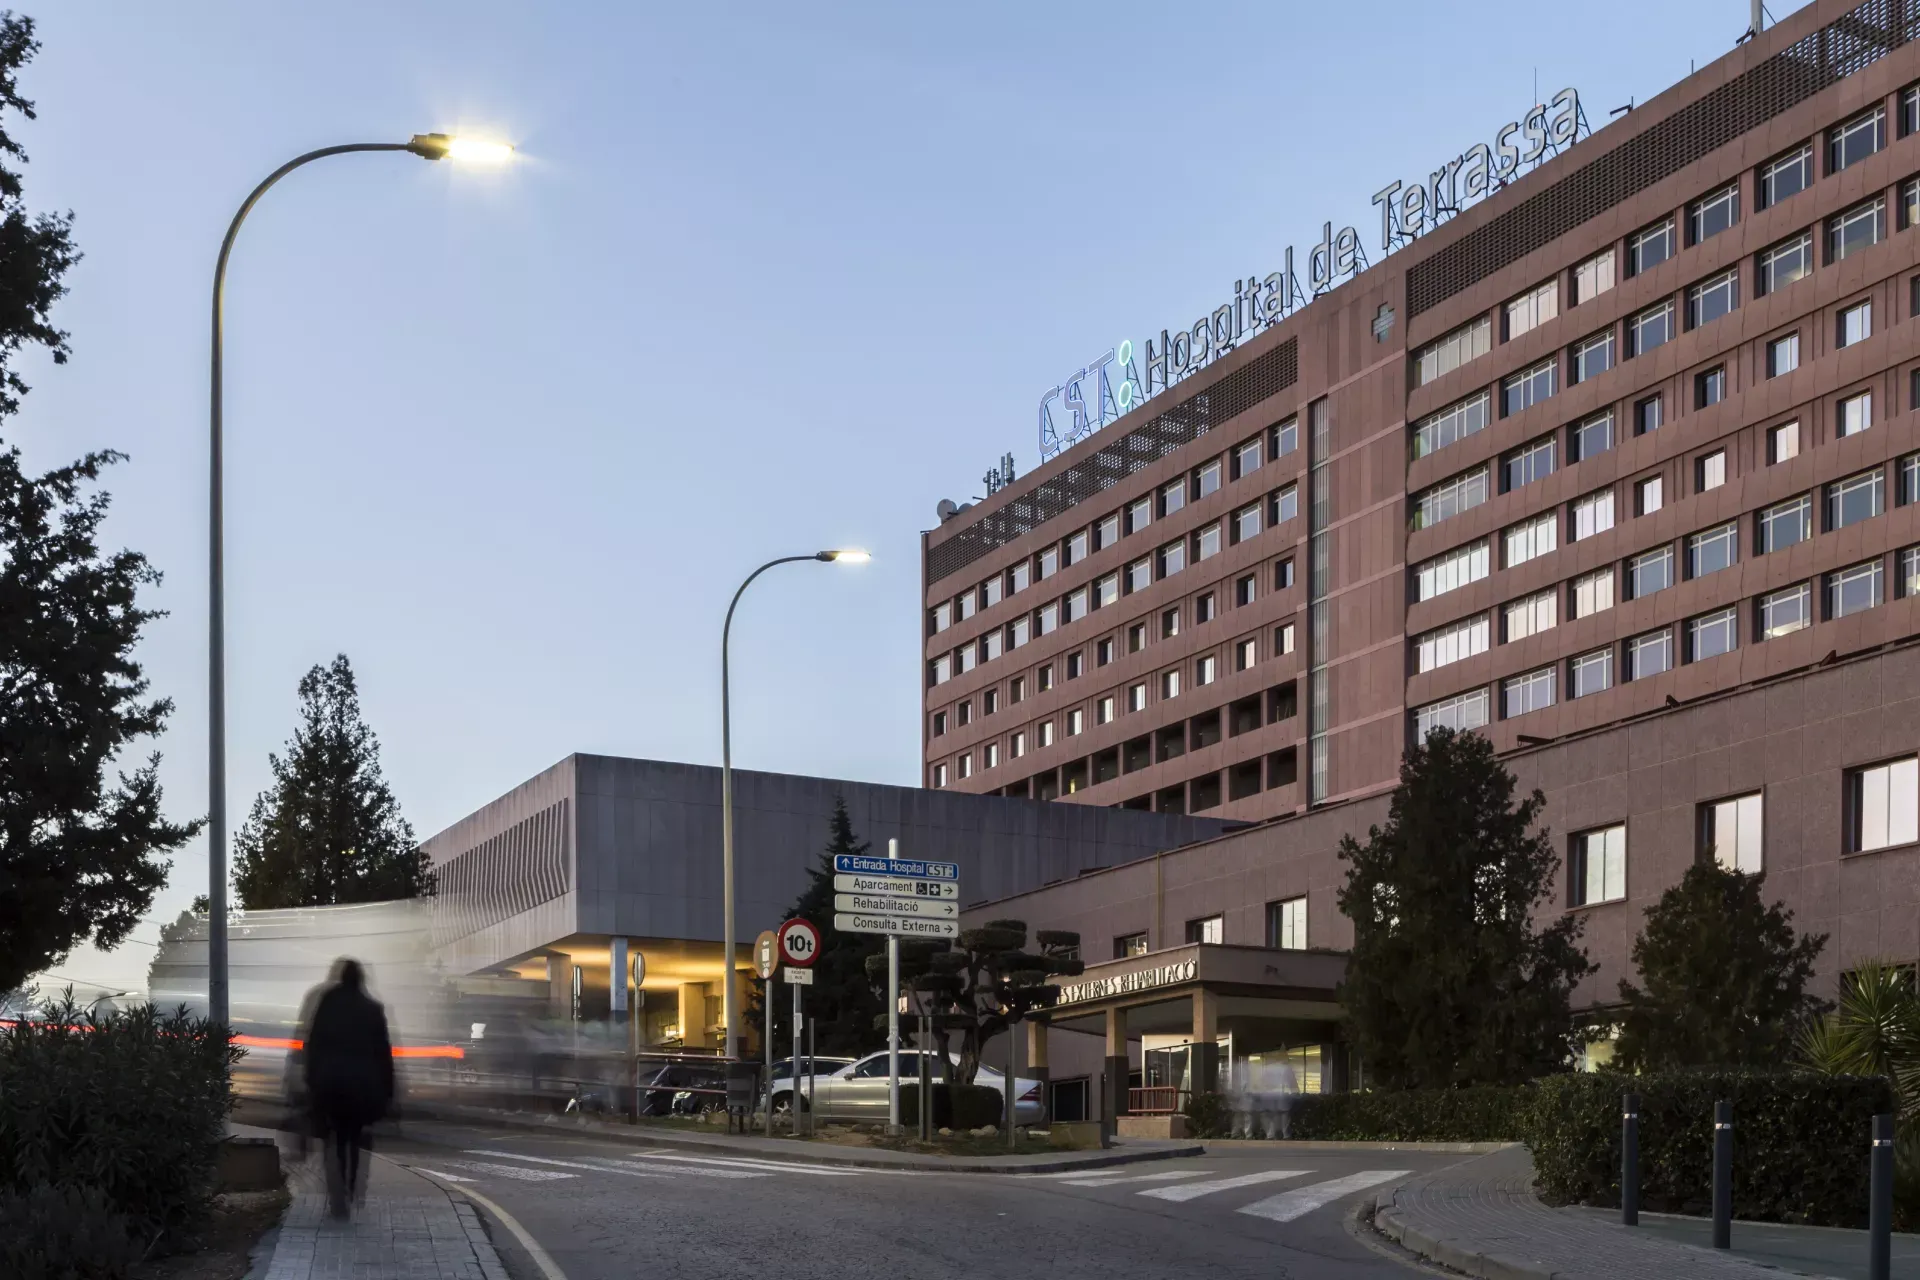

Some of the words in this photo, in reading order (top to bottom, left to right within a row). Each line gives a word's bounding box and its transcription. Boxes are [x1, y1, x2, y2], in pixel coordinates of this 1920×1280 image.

[1145, 245, 1293, 394] Hospital
[1308, 220, 1357, 293] de
[1371, 87, 1579, 250] Terrassa
[852, 857, 887, 871] Entrada
[889, 860, 925, 875] Hospital
[853, 877, 913, 892] Aparcament
[853, 897, 919, 912] Rehabilitació
[853, 916, 897, 930] Consulta
[902, 920, 941, 933] Externa
